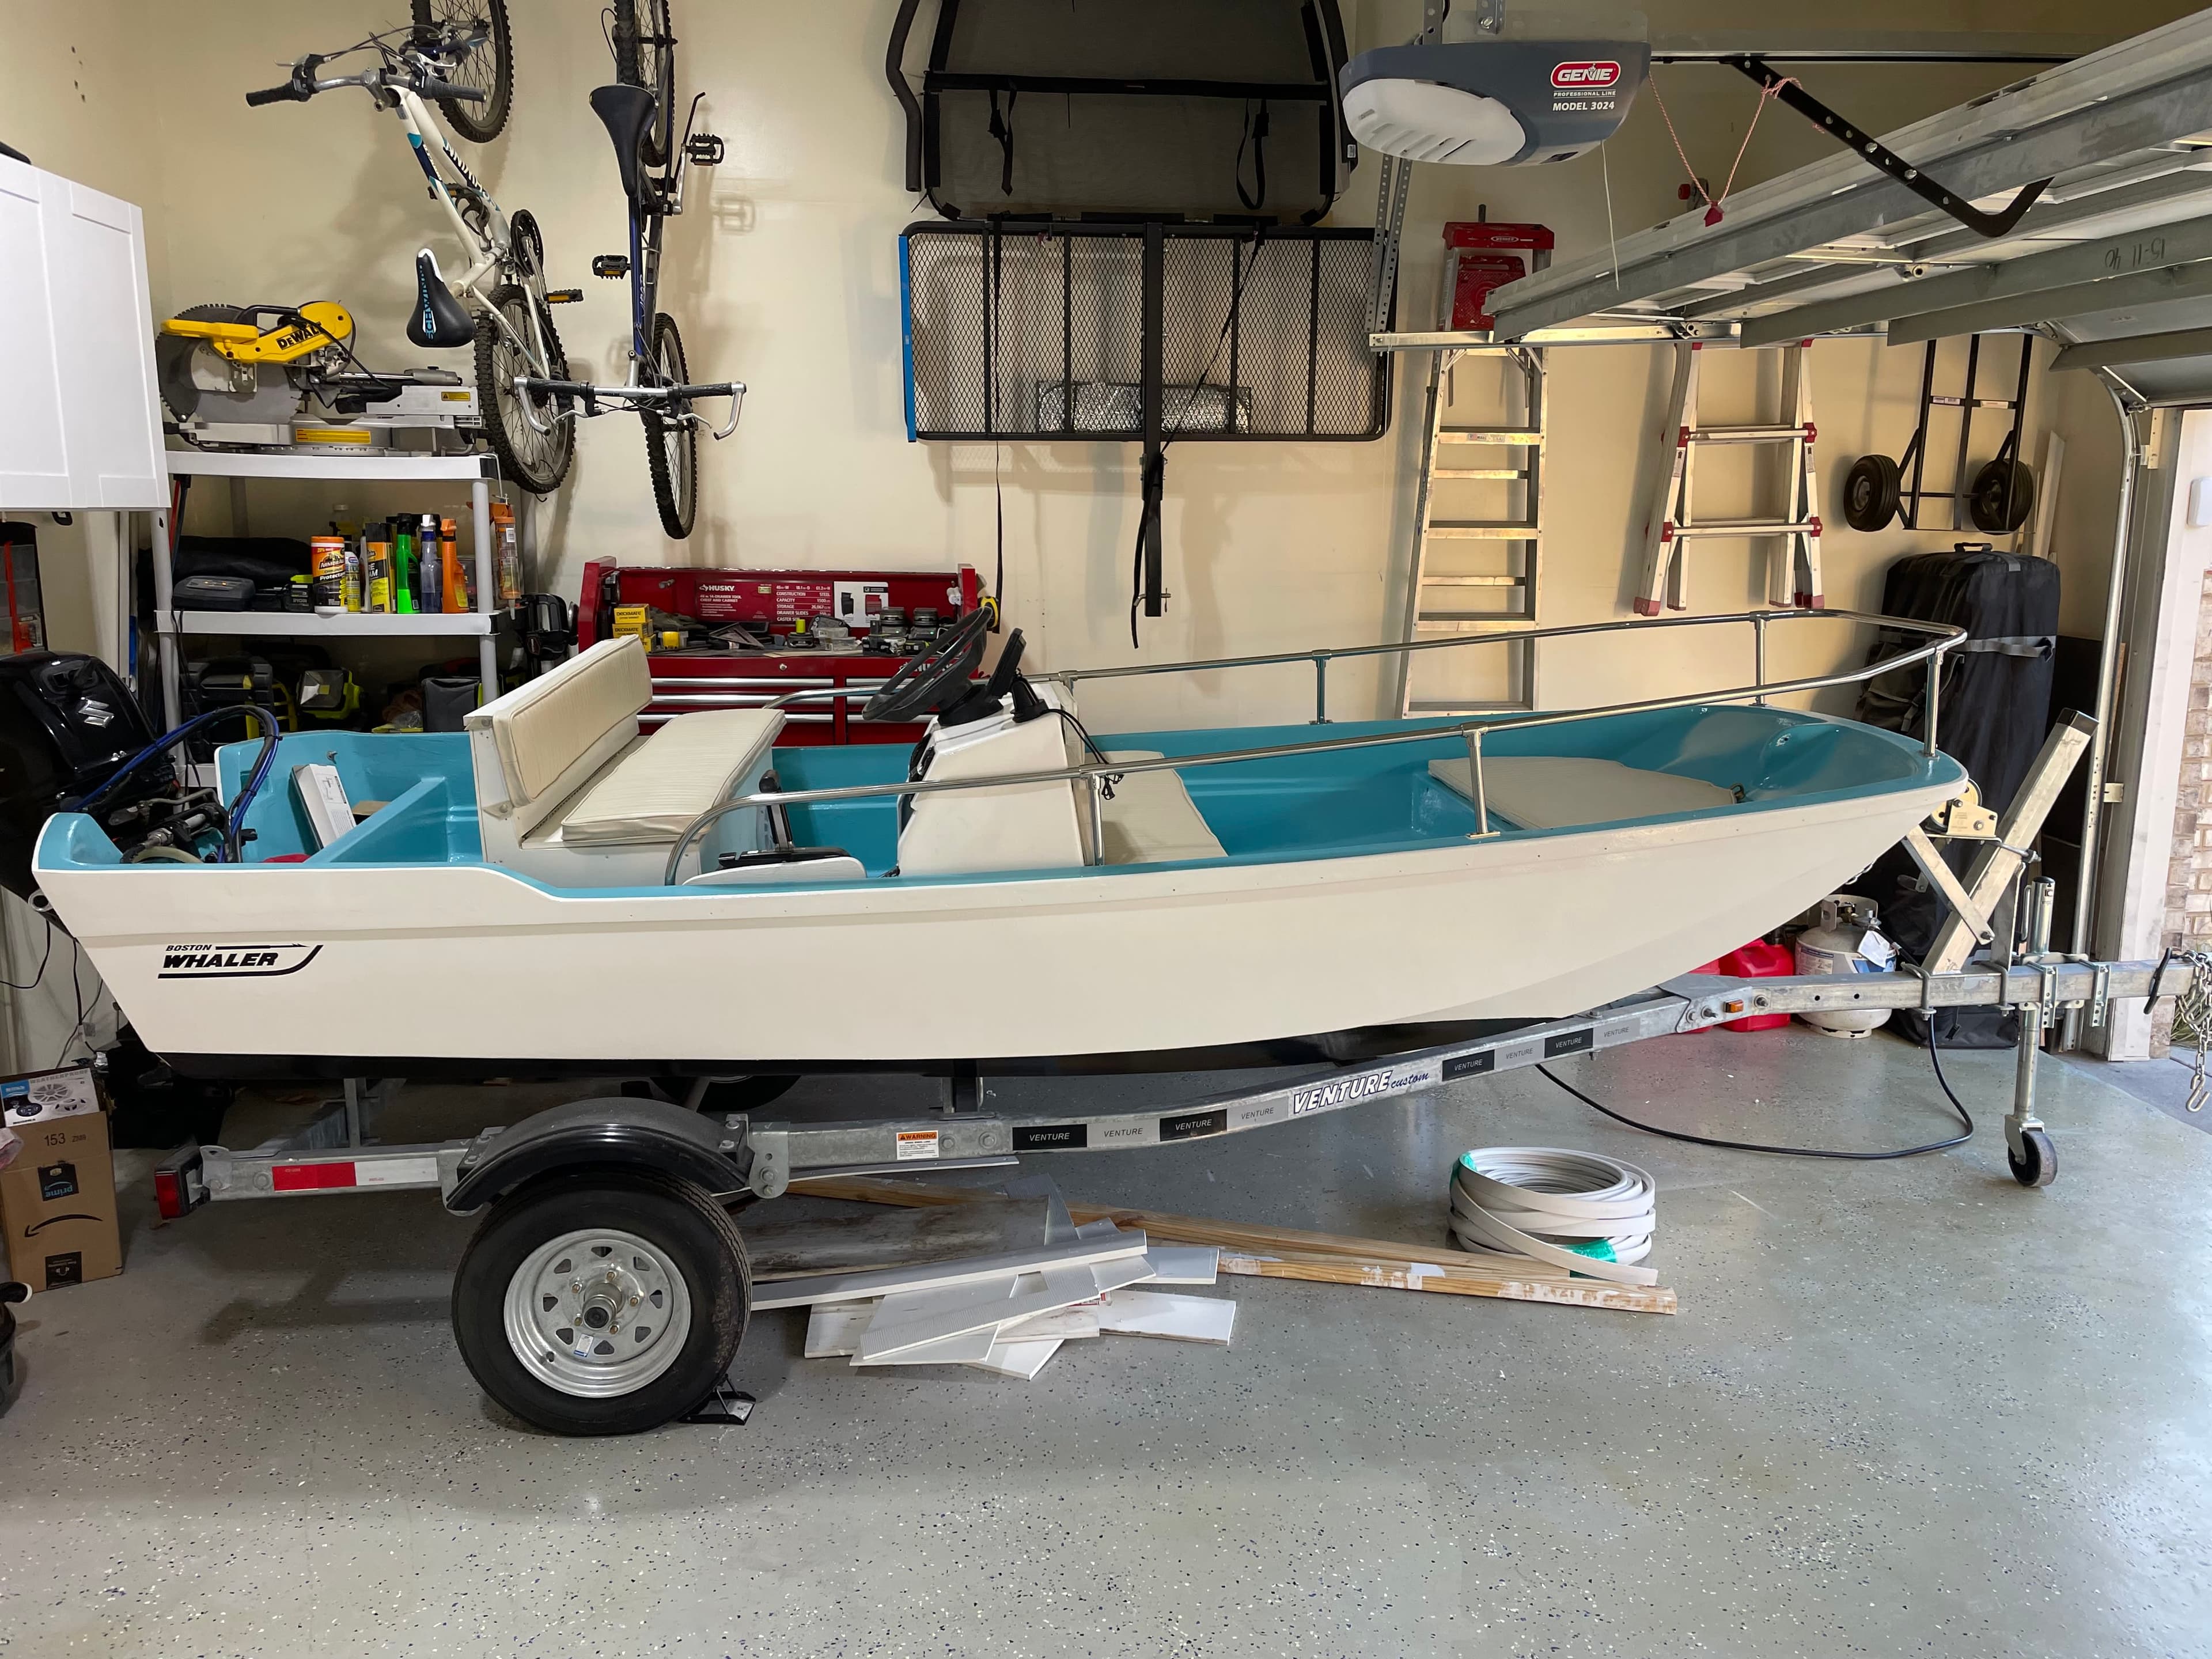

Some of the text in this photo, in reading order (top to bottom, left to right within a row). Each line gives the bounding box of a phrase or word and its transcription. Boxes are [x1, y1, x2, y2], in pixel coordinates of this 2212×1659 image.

[1558, 68, 1613, 81] GENIE
[1553, 101, 1615, 111] MODEL 3024
[276, 323, 321, 349] DEWAL
[163, 953, 278, 968] WHALER
[1603, 1026, 1630, 1038] VENTURE
[1555, 1037, 1582, 1049] VENTURE
[1506, 1048, 1533, 1060] VENTURE
[1454, 1059, 1483, 1071] VENTURE
[1293, 1070, 1430, 1115] VENTURE custom
[1241, 1107, 1274, 1120] VENTURE
[1175, 1119, 1212, 1131] VENTURE
[1029, 1132, 1070, 1142] VENTURE
[1104, 1127, 1143, 1138] VENTURE
[44, 1132, 66, 1146] 153
[46, 1184, 73, 1198] prime
